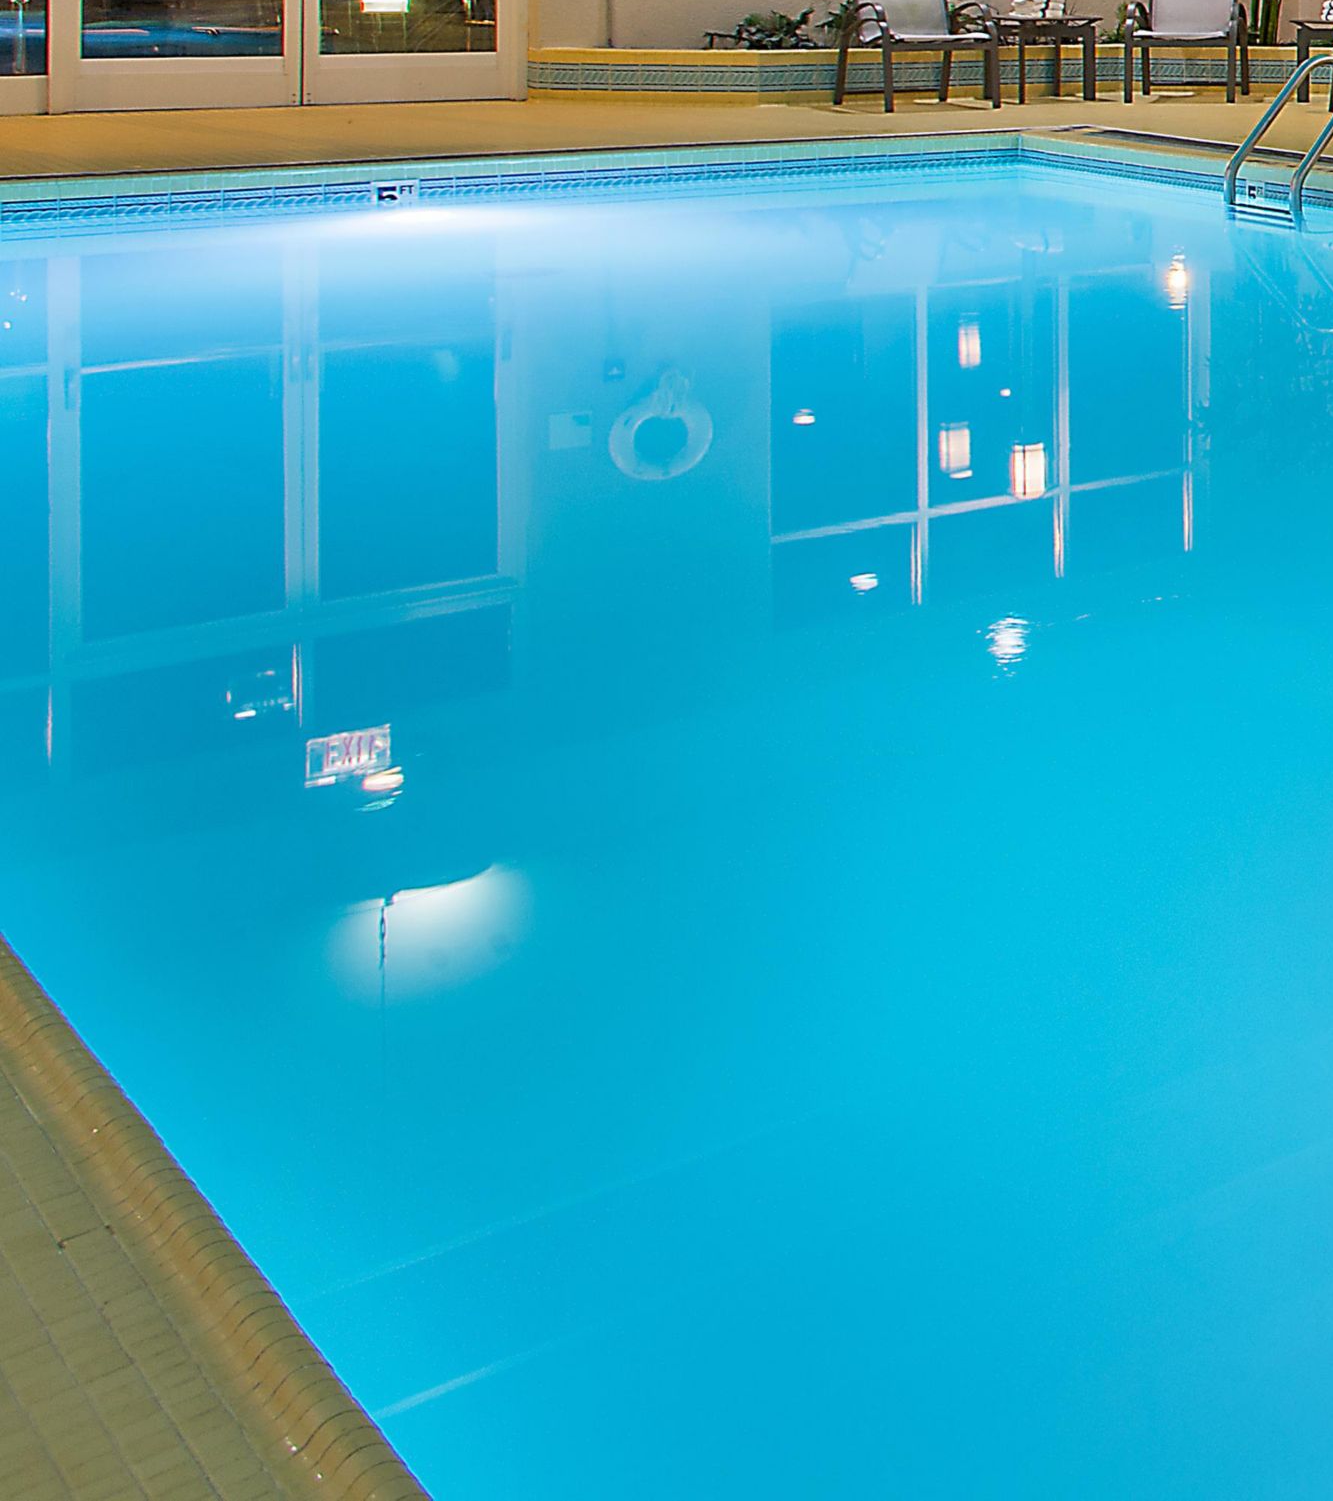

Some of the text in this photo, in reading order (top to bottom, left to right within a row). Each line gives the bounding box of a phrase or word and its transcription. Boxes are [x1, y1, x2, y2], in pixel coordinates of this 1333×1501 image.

[377, 185, 415, 201] 5 FT
[1247, 185, 1257, 199] 5
